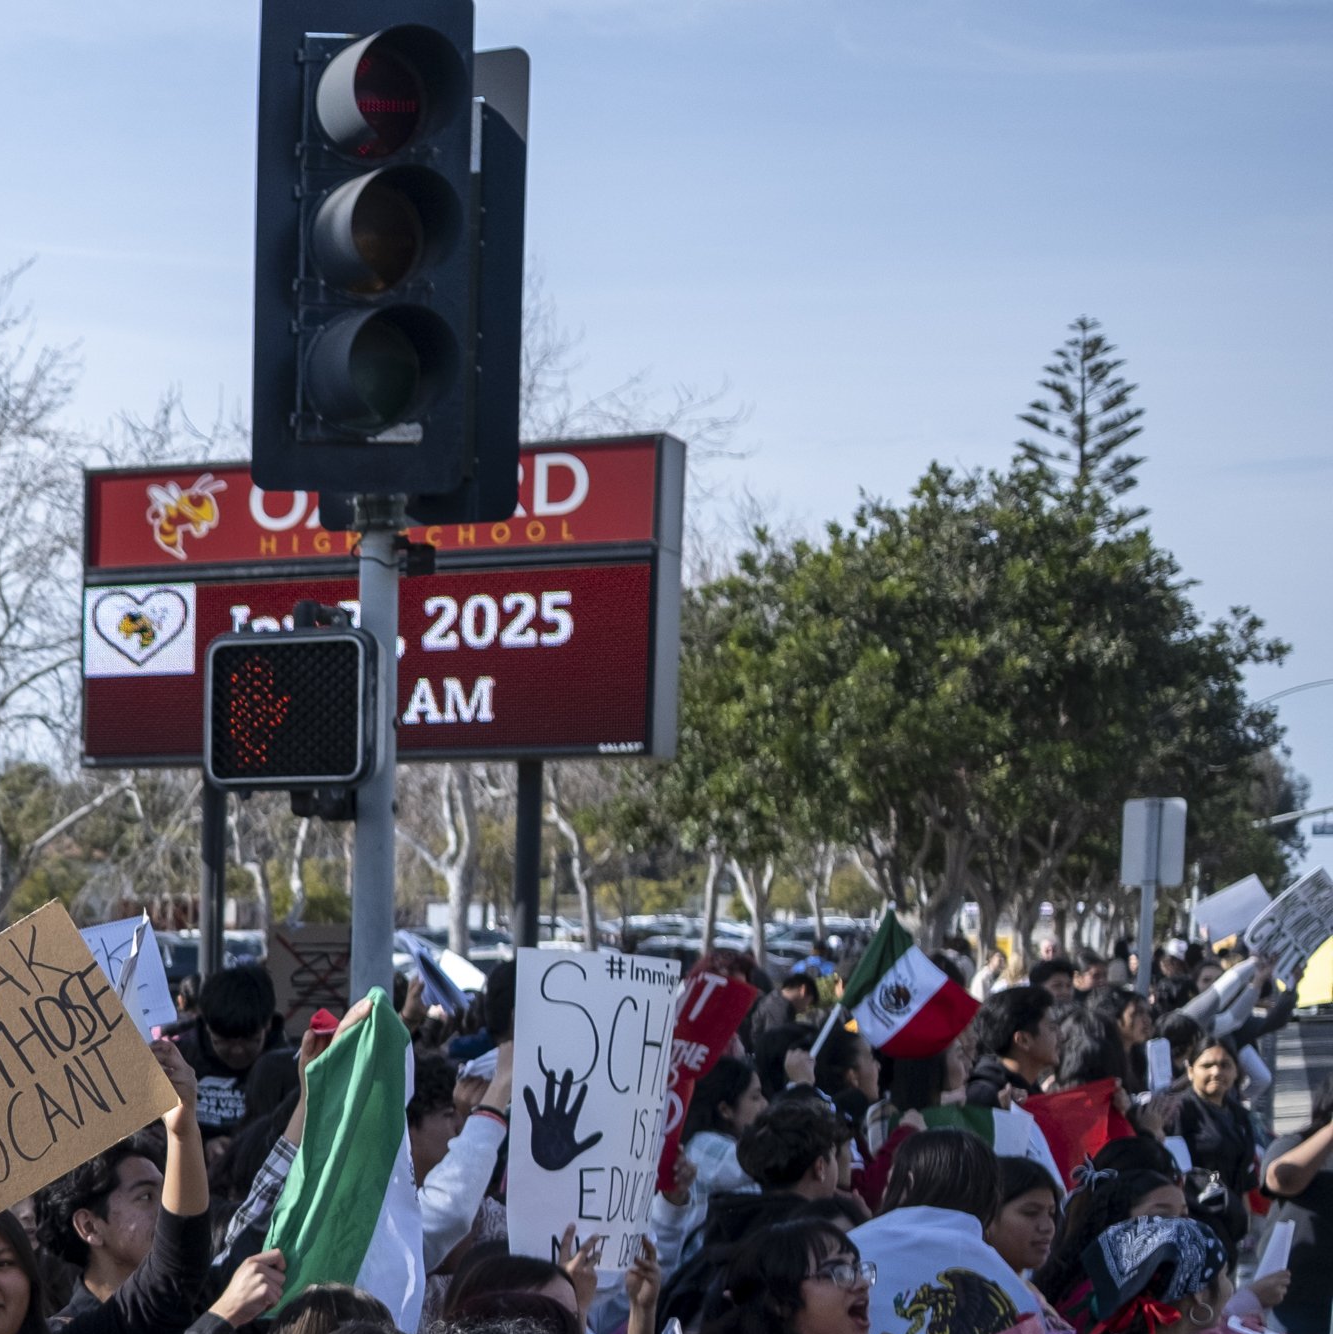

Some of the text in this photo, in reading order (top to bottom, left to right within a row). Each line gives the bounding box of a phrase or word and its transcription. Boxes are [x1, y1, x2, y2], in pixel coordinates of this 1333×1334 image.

[399, 519, 575, 549] CHOOL
[421, 590, 574, 652] 2025
[402, 676, 496, 724] AM
[7, 1033, 127, 1162] CANT
[551, 1234, 612, 1268] NT
